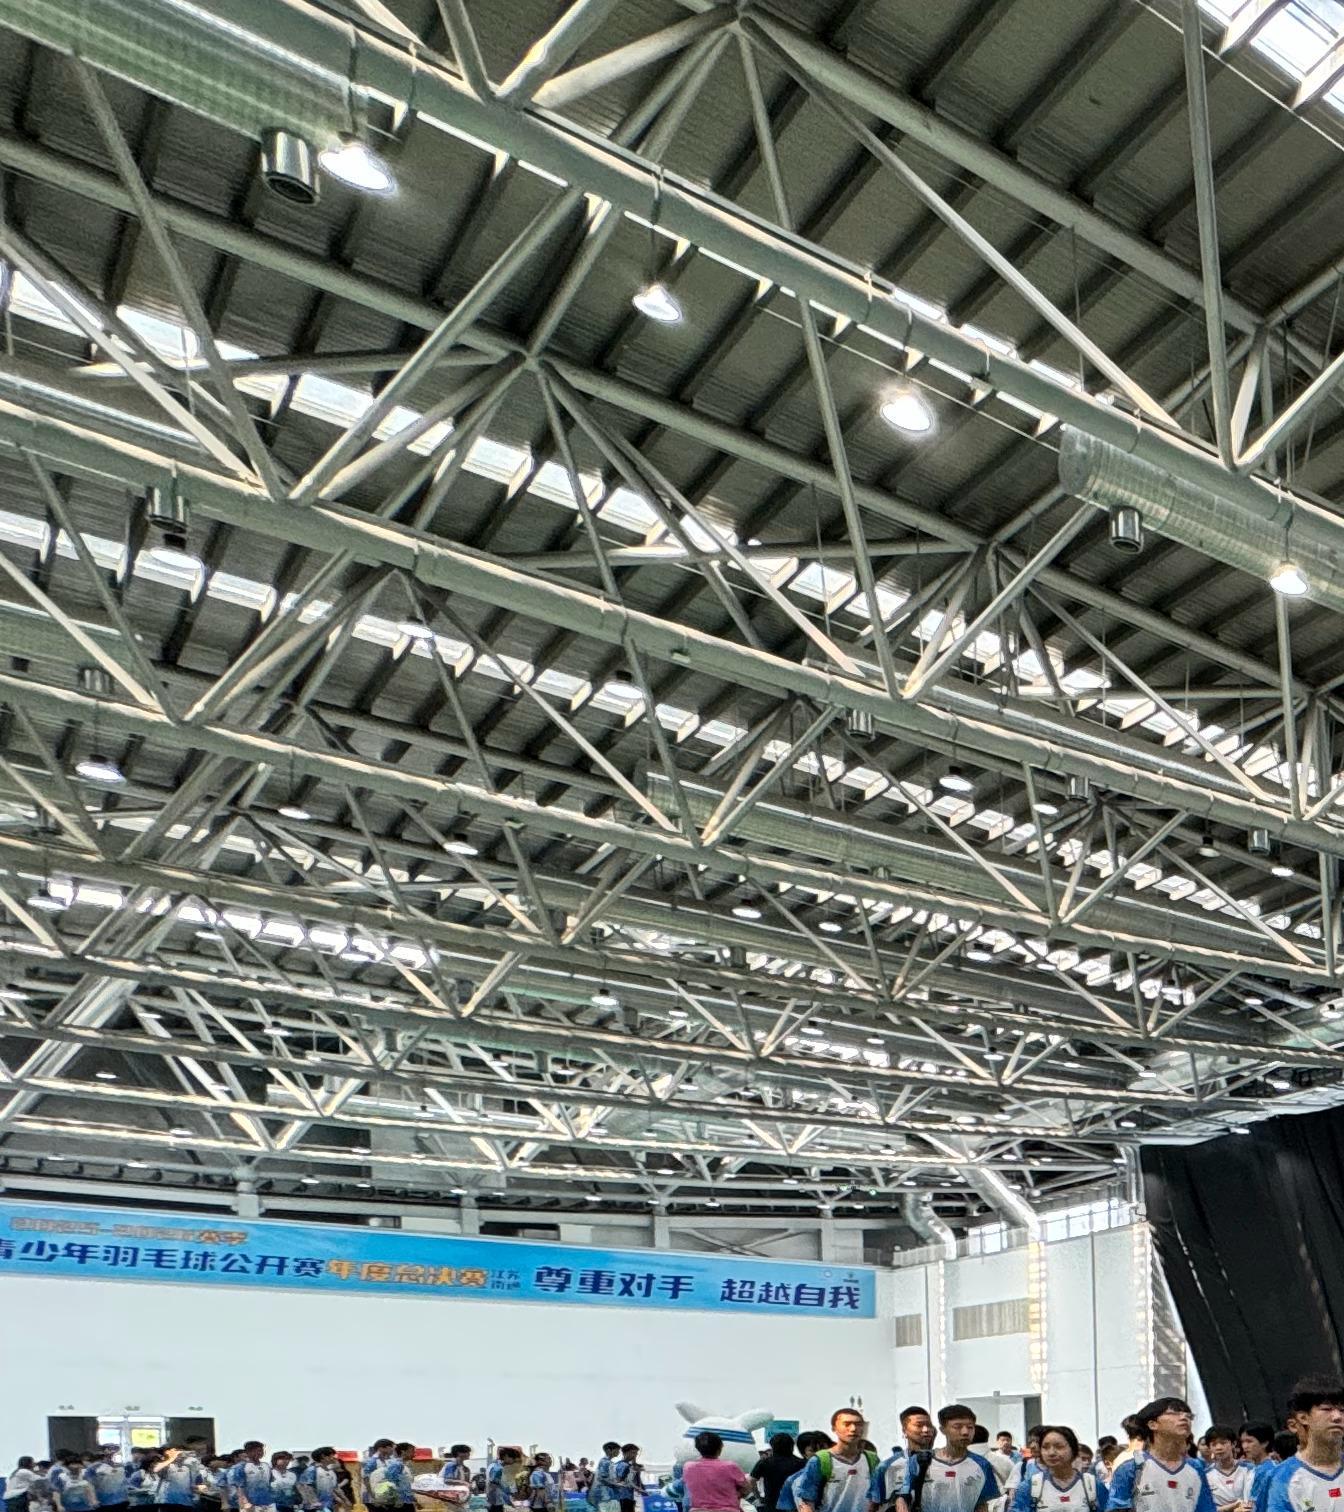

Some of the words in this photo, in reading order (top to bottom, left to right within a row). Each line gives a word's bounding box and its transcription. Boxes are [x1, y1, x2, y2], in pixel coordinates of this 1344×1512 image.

[533, 1266, 695, 1299] 尊重对手
[719, 1277, 861, 1310] 超越自我
